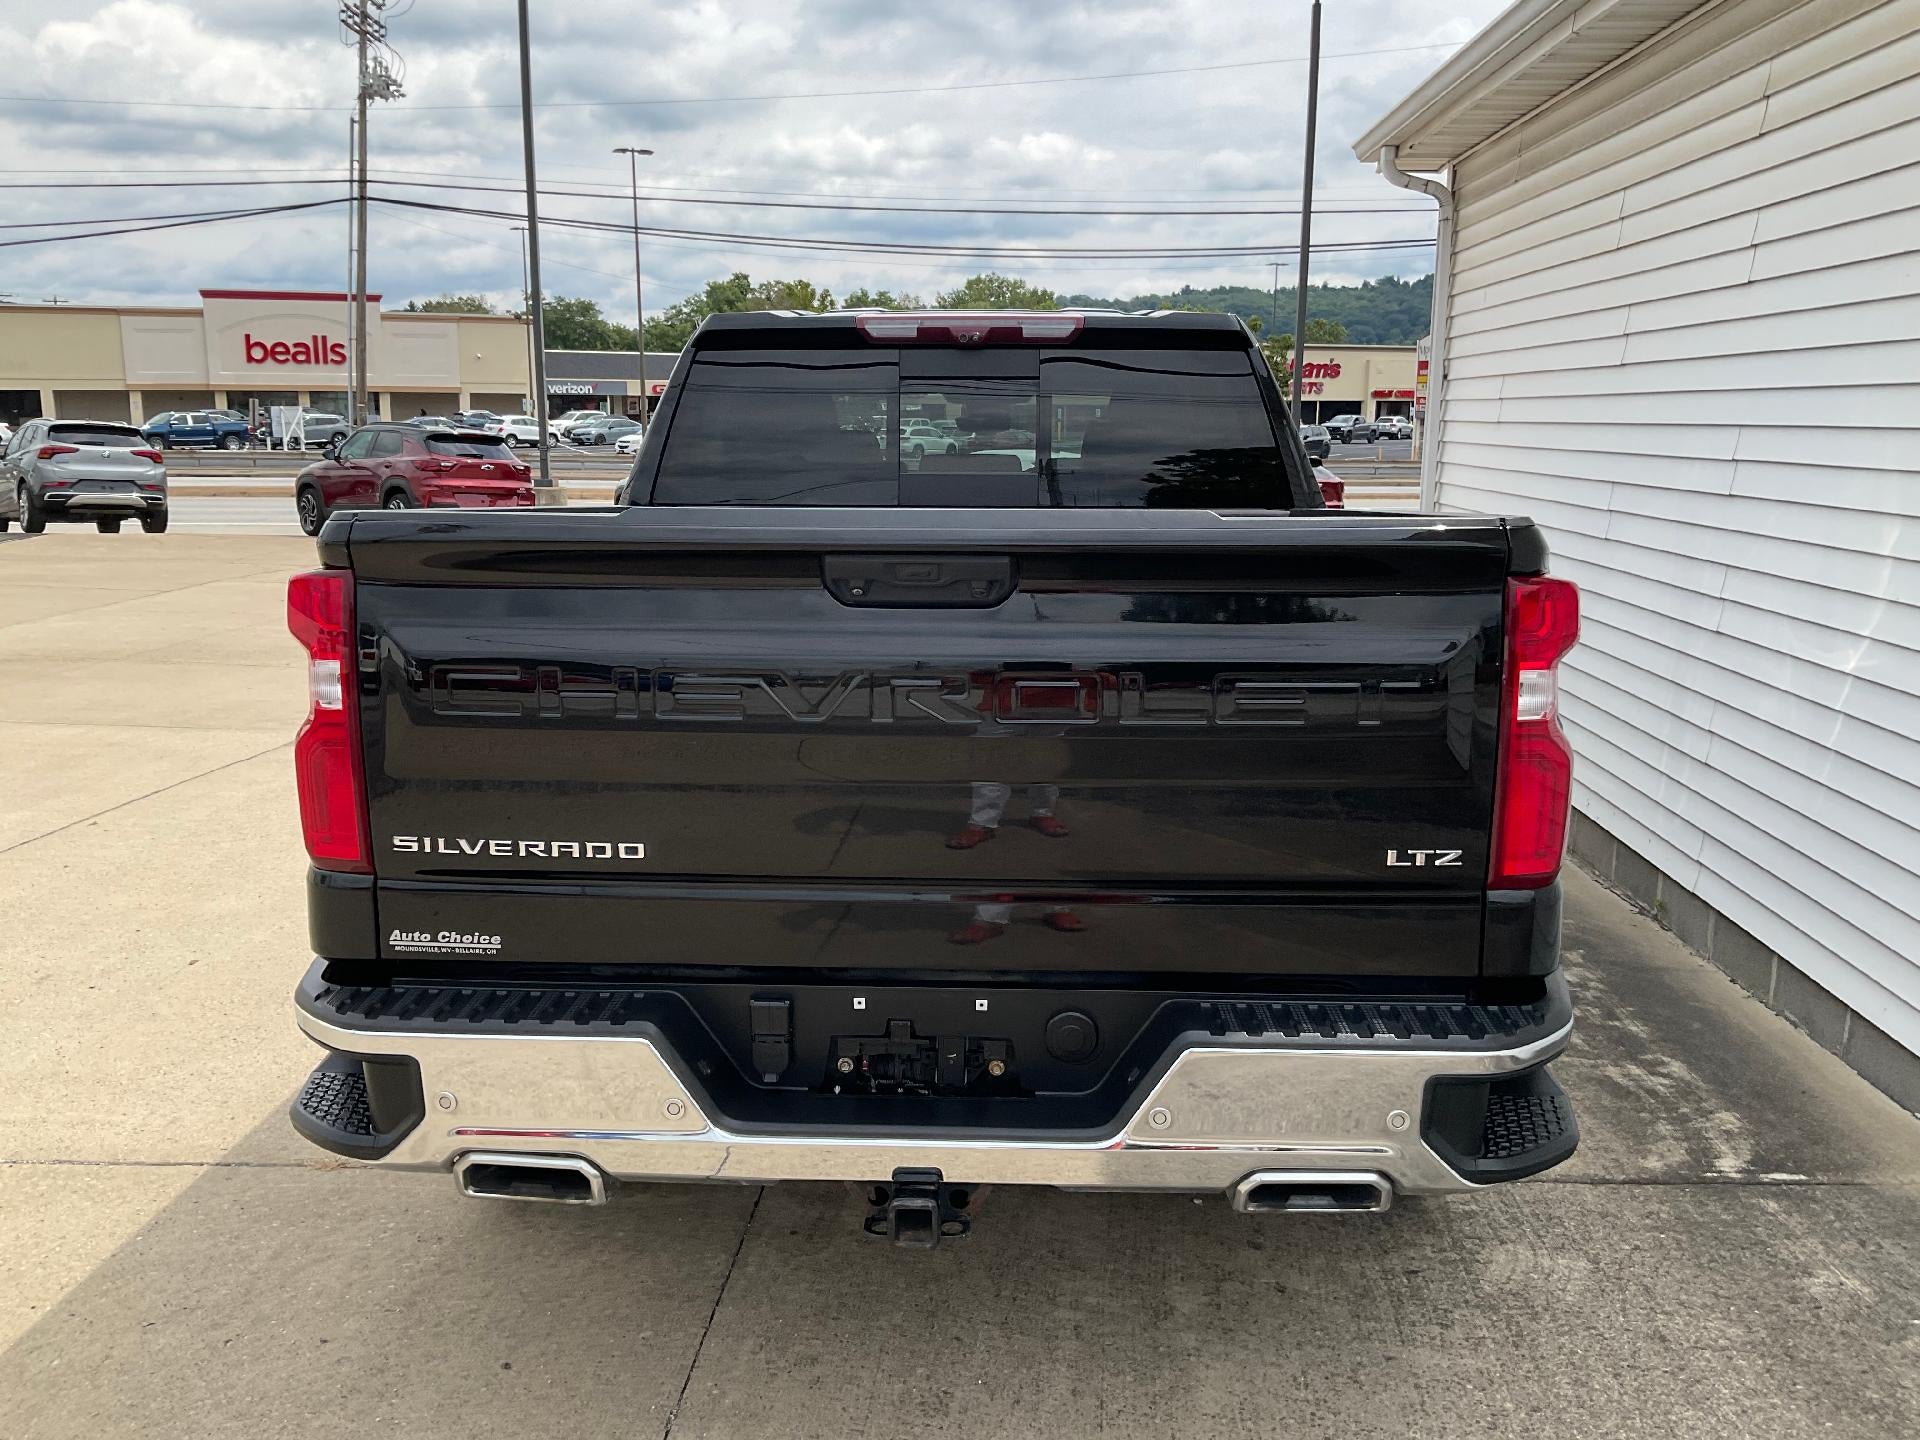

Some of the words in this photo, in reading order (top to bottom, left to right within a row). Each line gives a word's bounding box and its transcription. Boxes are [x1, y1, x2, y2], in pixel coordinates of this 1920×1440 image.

[244, 333, 347, 365] bealls
[547, 382, 593, 394] verizon
[431, 666, 1421, 727] CHEVROLET
[392, 835, 646, 859] SILVERADO
[1386, 849, 1463, 866] LTZ
[389, 929, 431, 942] Auto
[437, 931, 502, 944] Choice
